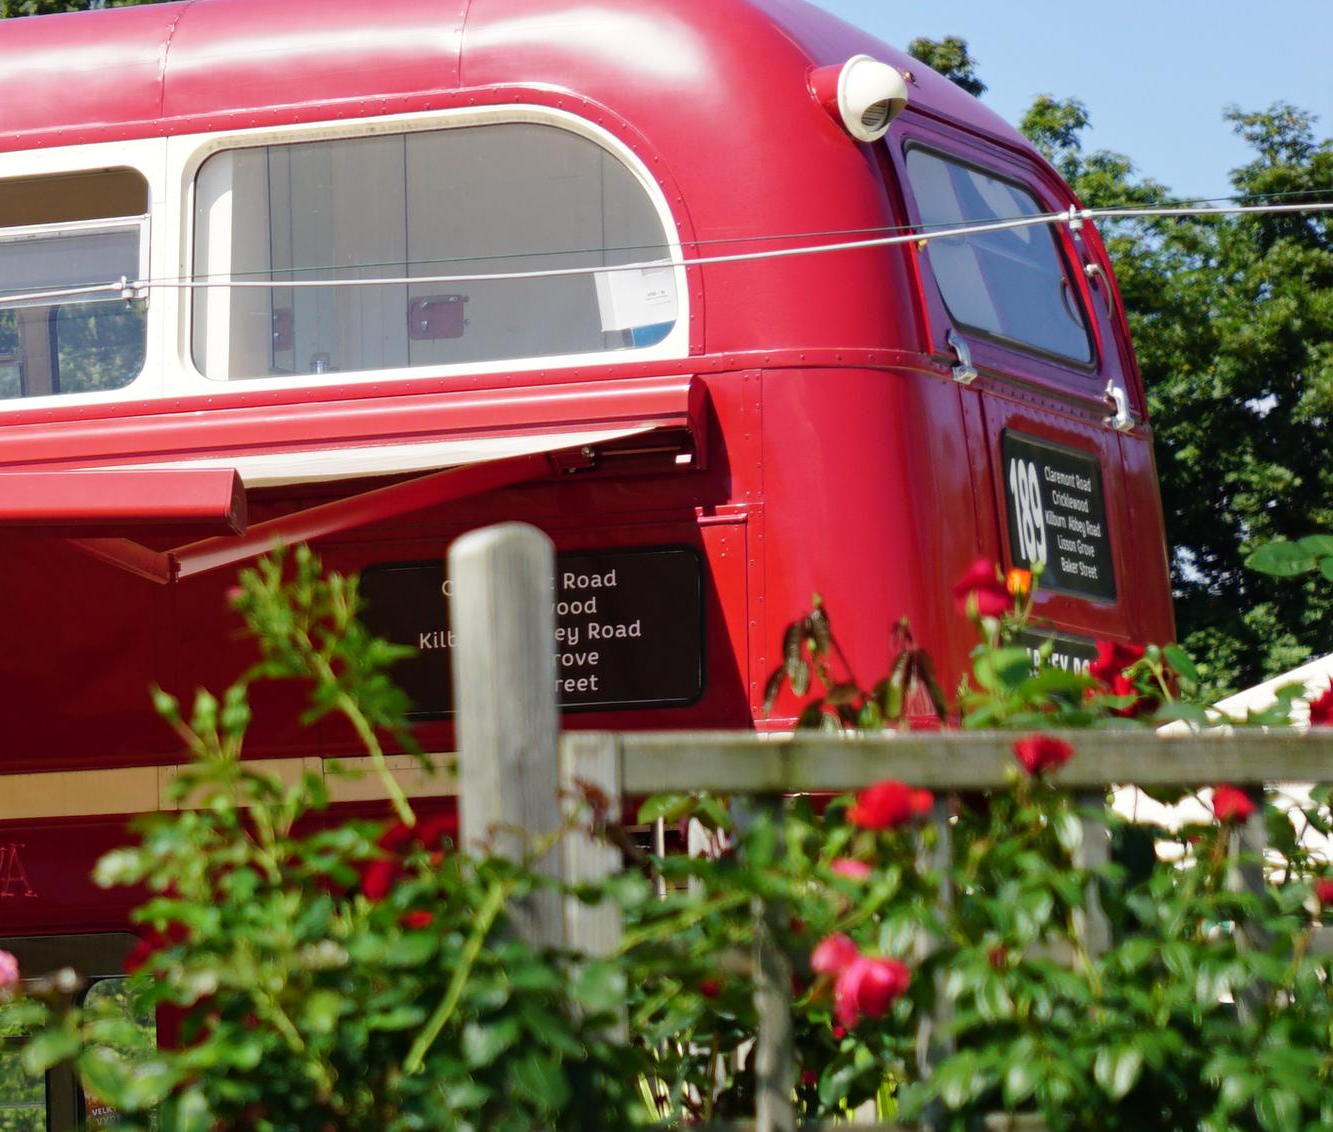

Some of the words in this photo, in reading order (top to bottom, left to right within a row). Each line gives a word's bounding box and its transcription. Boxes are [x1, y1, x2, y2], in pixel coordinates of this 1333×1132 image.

[1044, 466, 1075, 488] Claremont
[1076, 475, 1091, 493] Road
[1010, 458, 1047, 565] 189
[1052, 490, 1089, 513] Cricklewood
[1068, 515, 1087, 538] Abbey
[1085, 520, 1102, 537] Road
[1076, 539, 1095, 557] Grove
[563, 569, 618, 590] Road
[1060, 557, 1079, 574] Baker
[1079, 561, 1098, 580] Street
[587, 620, 642, 640] Road
[552, 650, 600, 668] rove
[554, 675, 599, 693] reet
